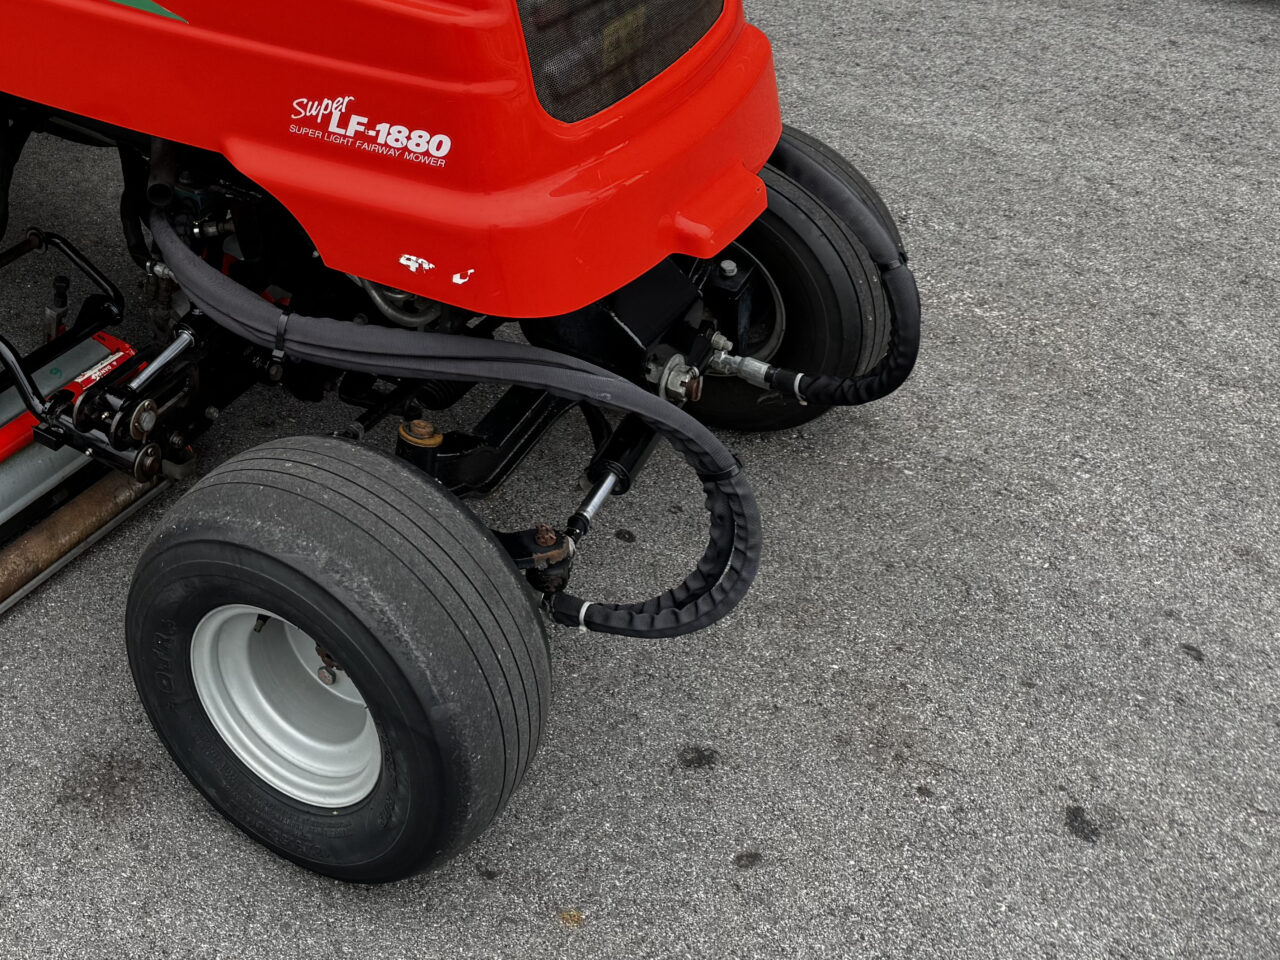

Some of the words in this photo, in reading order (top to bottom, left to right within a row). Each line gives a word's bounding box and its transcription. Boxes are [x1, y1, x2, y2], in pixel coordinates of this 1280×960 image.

[291, 96, 355, 123] Super
[289, 124, 322, 139] SUPER
[324, 132, 354, 147] LIGHT
[355, 140, 402, 157] FAIRWAY
[403, 151, 446, 167] MOWER
[328, 110, 452, 157] LF-1880
